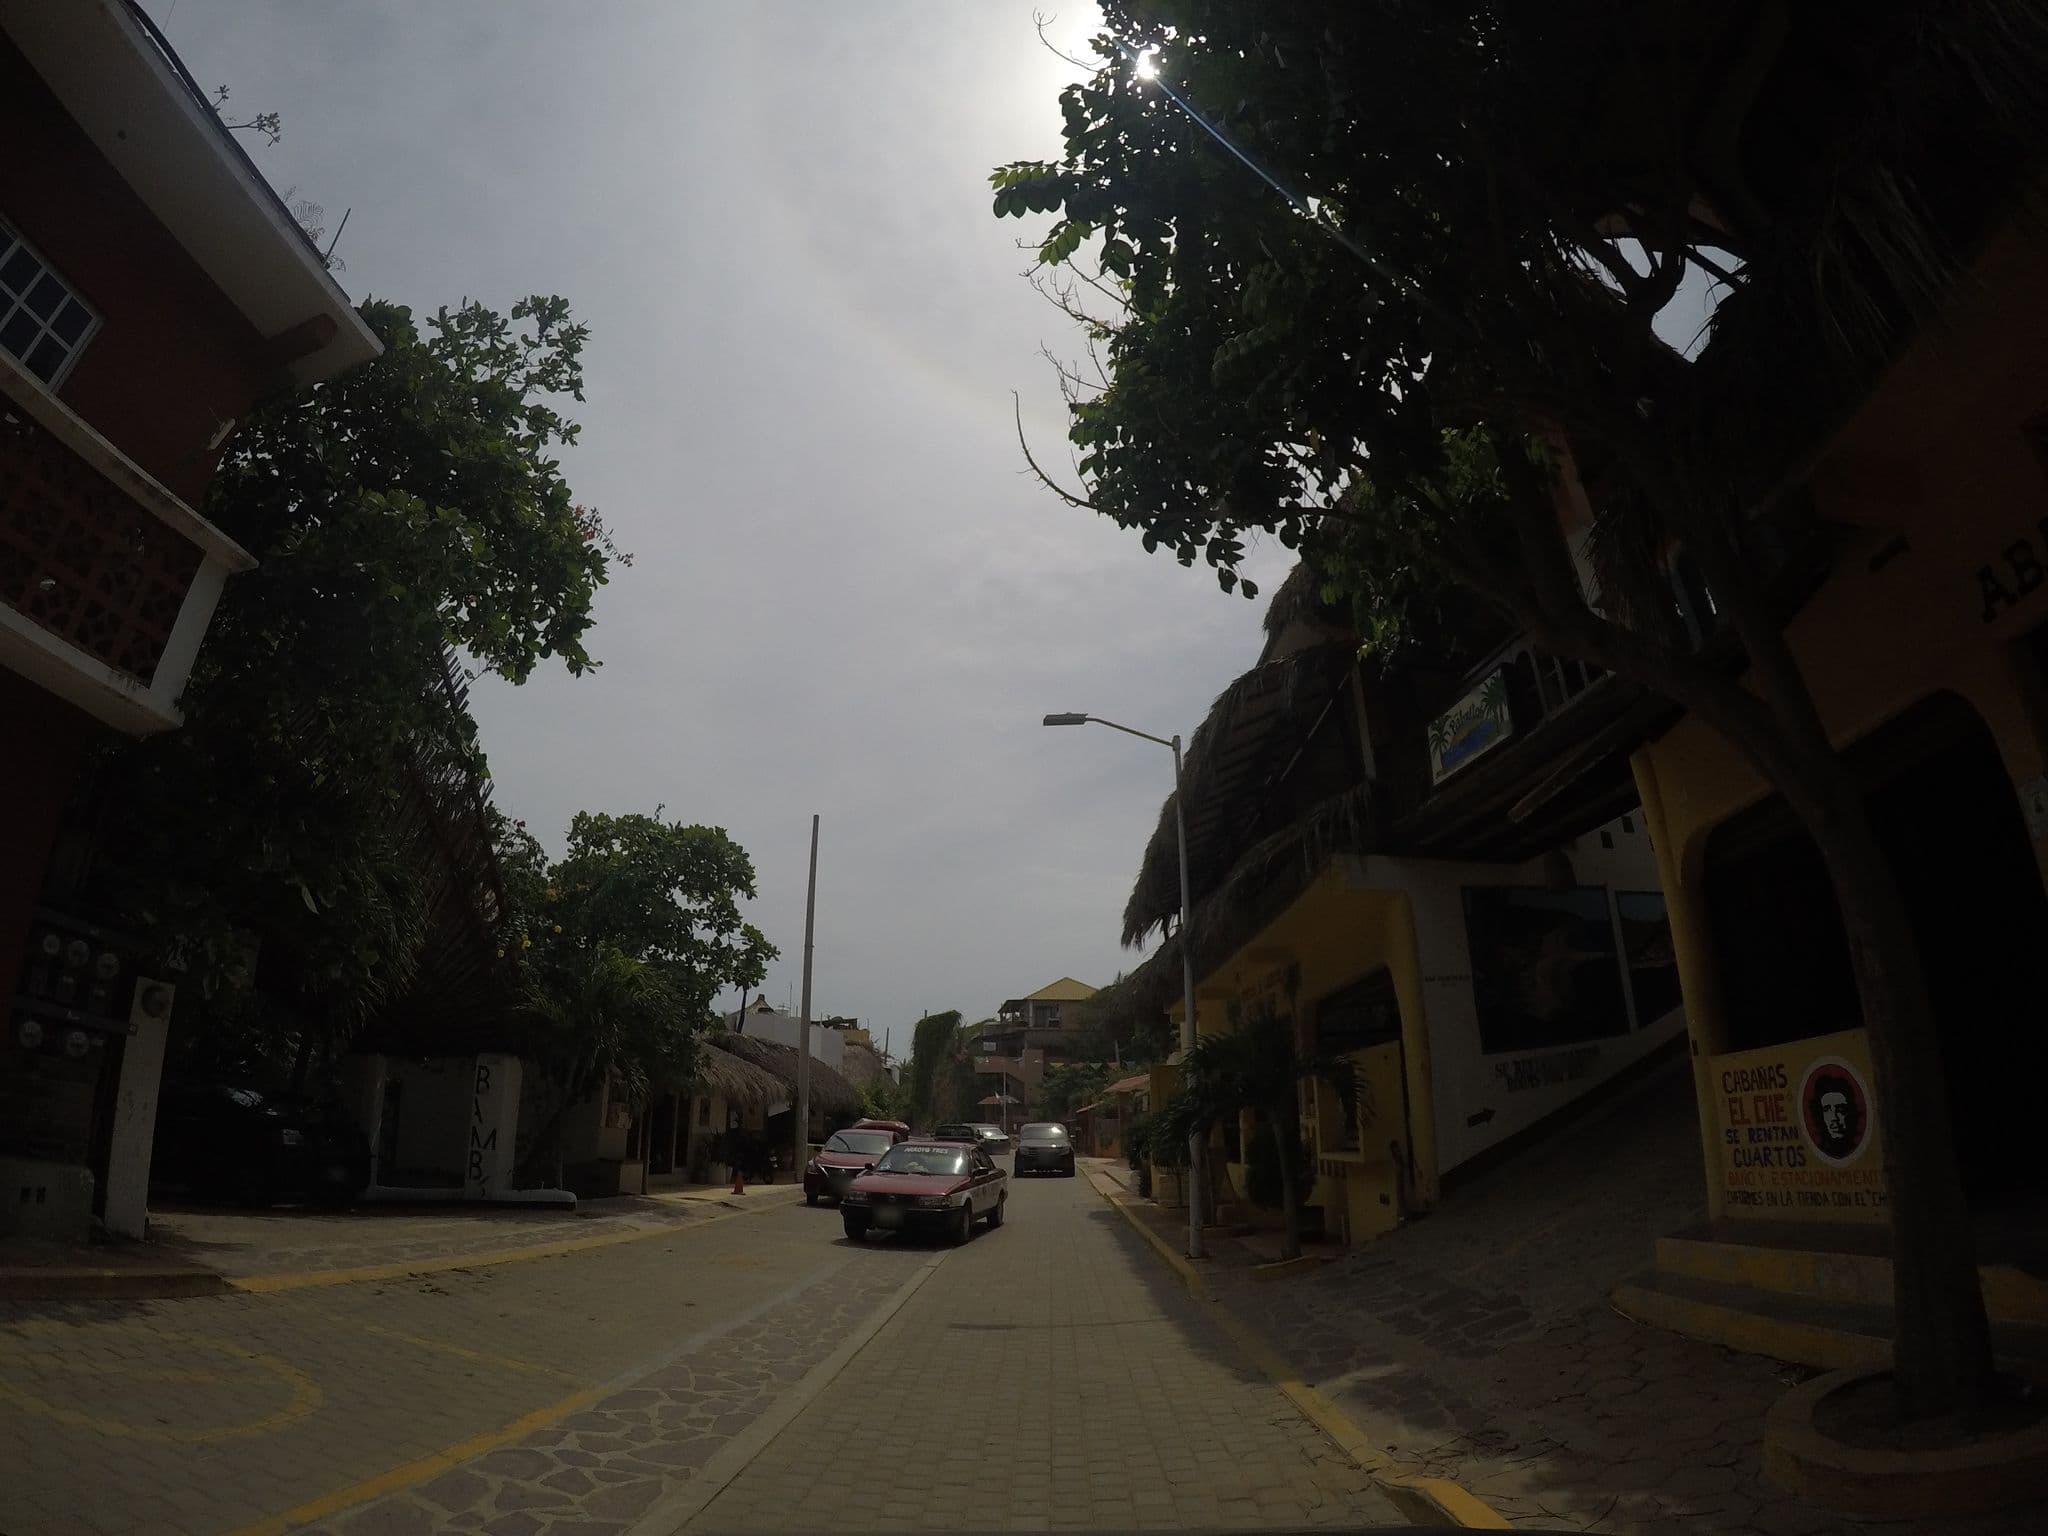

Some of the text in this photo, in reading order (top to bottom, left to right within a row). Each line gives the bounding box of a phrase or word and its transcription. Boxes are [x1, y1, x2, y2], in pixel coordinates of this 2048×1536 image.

[1726, 1126, 1799, 1145] SE RENTAN
[1734, 1144, 1807, 1168] CUARTOS
